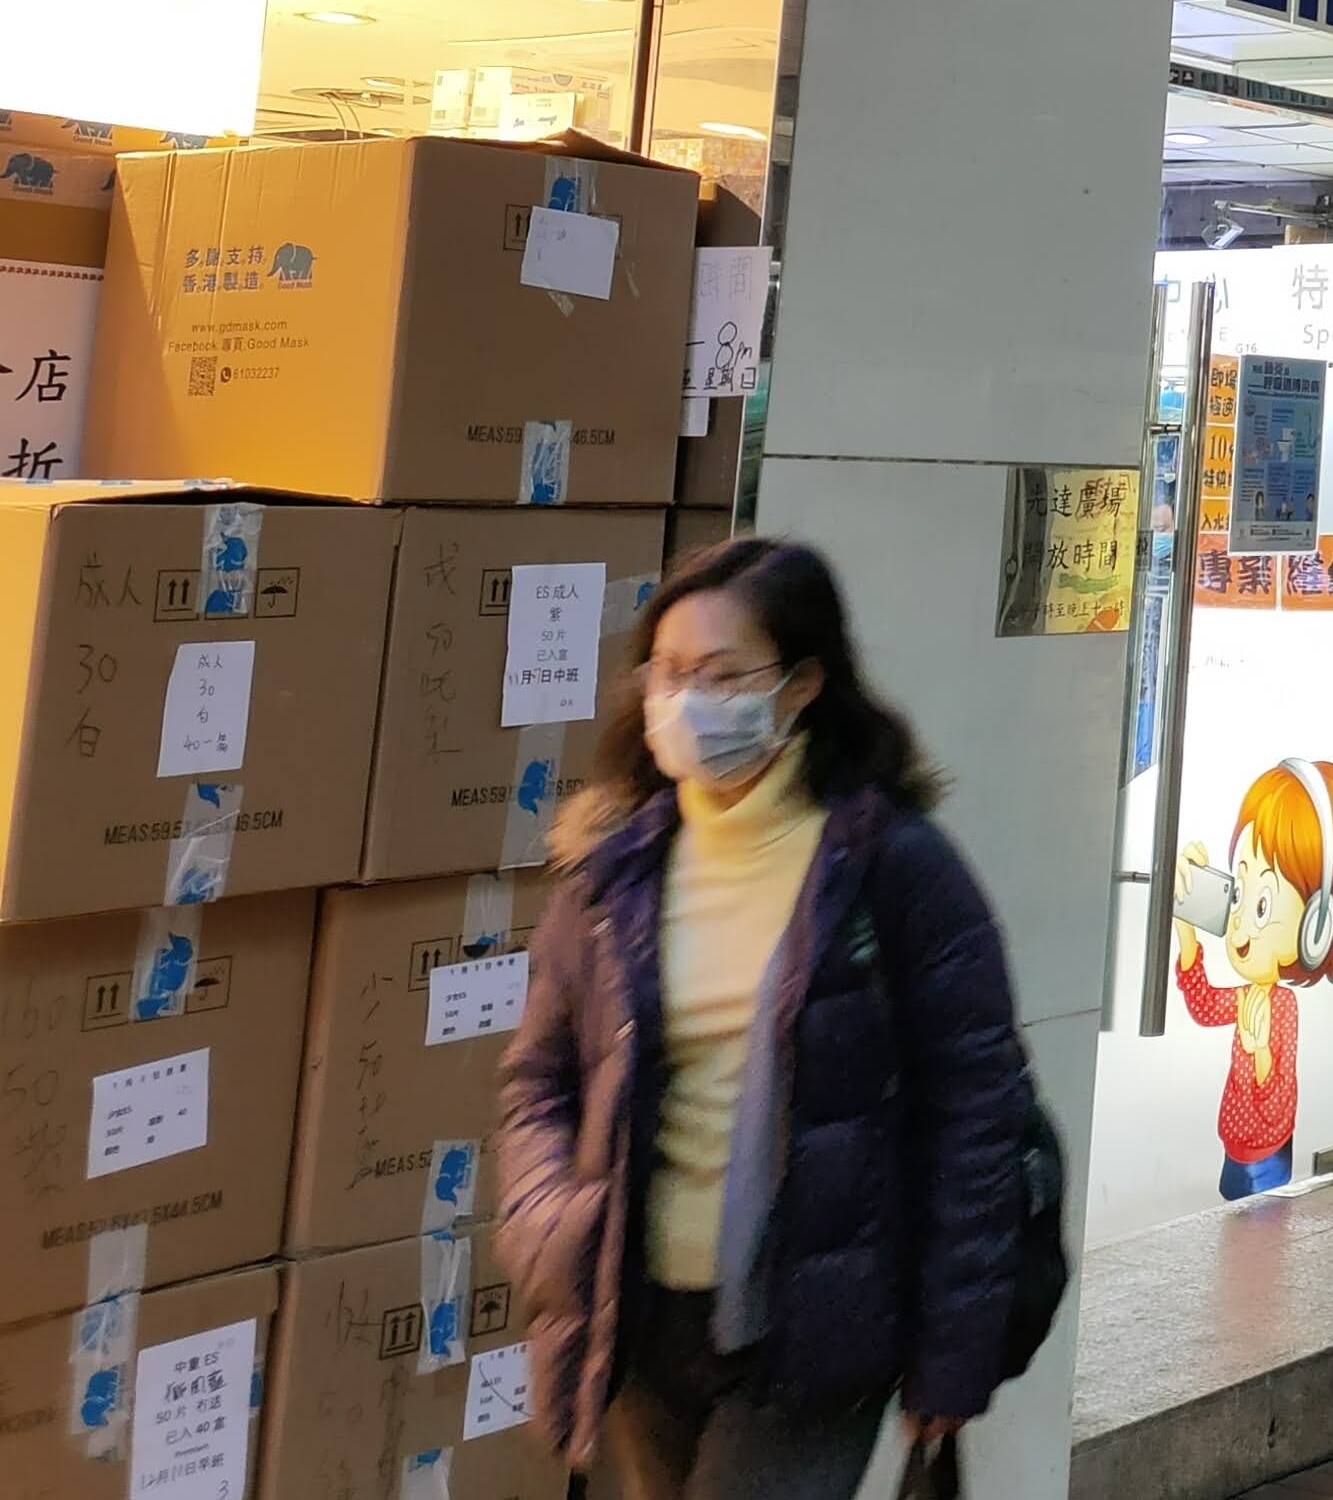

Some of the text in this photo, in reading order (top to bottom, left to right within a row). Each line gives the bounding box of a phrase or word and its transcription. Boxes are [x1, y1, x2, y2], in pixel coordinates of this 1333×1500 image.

[247, 337, 277, 350] Good
[279, 336, 310, 349] Mask
[1026, 479, 1123, 520] 先達廣場
[1022, 538, 1118, 574] 開放時間
[552, 583, 580, 600] 成人
[74, 642, 119, 696] 30
